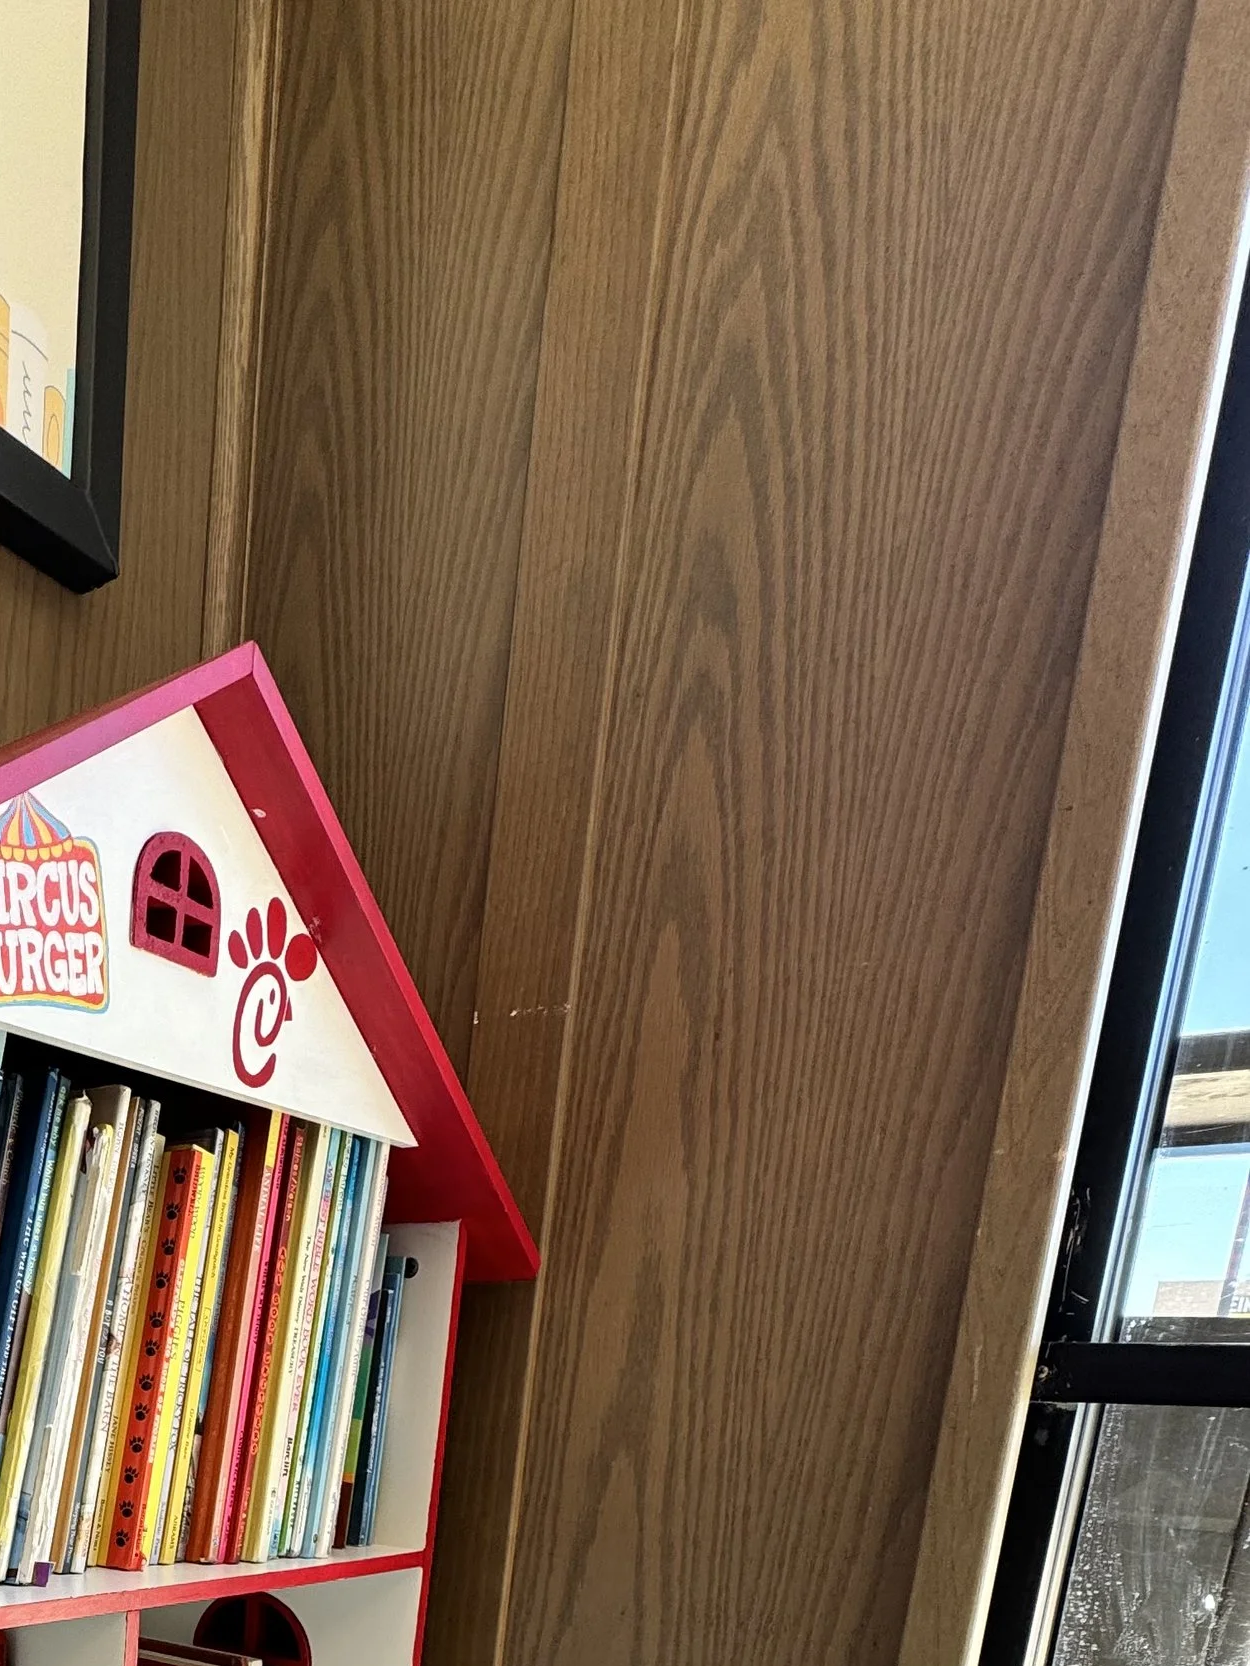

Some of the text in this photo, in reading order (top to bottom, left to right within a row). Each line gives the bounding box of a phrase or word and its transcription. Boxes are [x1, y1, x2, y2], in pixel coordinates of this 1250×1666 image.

[228, 1147, 233, 1157] My
[38, 1159, 54, 1211] Which bug
[258, 1169, 270, 1218] ANIMAL
[192, 1275, 202, 1303] THE
[292, 1189, 329, 1412] BEST BIBLE WORD BOOK EVER
[294, 1295, 302, 1323] Disney
[170, 1300, 184, 1360] PIGGIES
[186, 1309, 196, 1343] TALE
[97, 1346, 105, 1363] YOU
[100, 1286, 129, 1432] HOME THE BARN
[287, 1327, 298, 1374] TREASURY
[174, 1371, 187, 1418] TRICKY
[105, 1415, 118, 1472] JANE HISSEY
[168, 1426, 178, 1451] FOX
[282, 1437, 292, 1477] Barclift
[169, 1515, 177, 1548] ABRAMS
